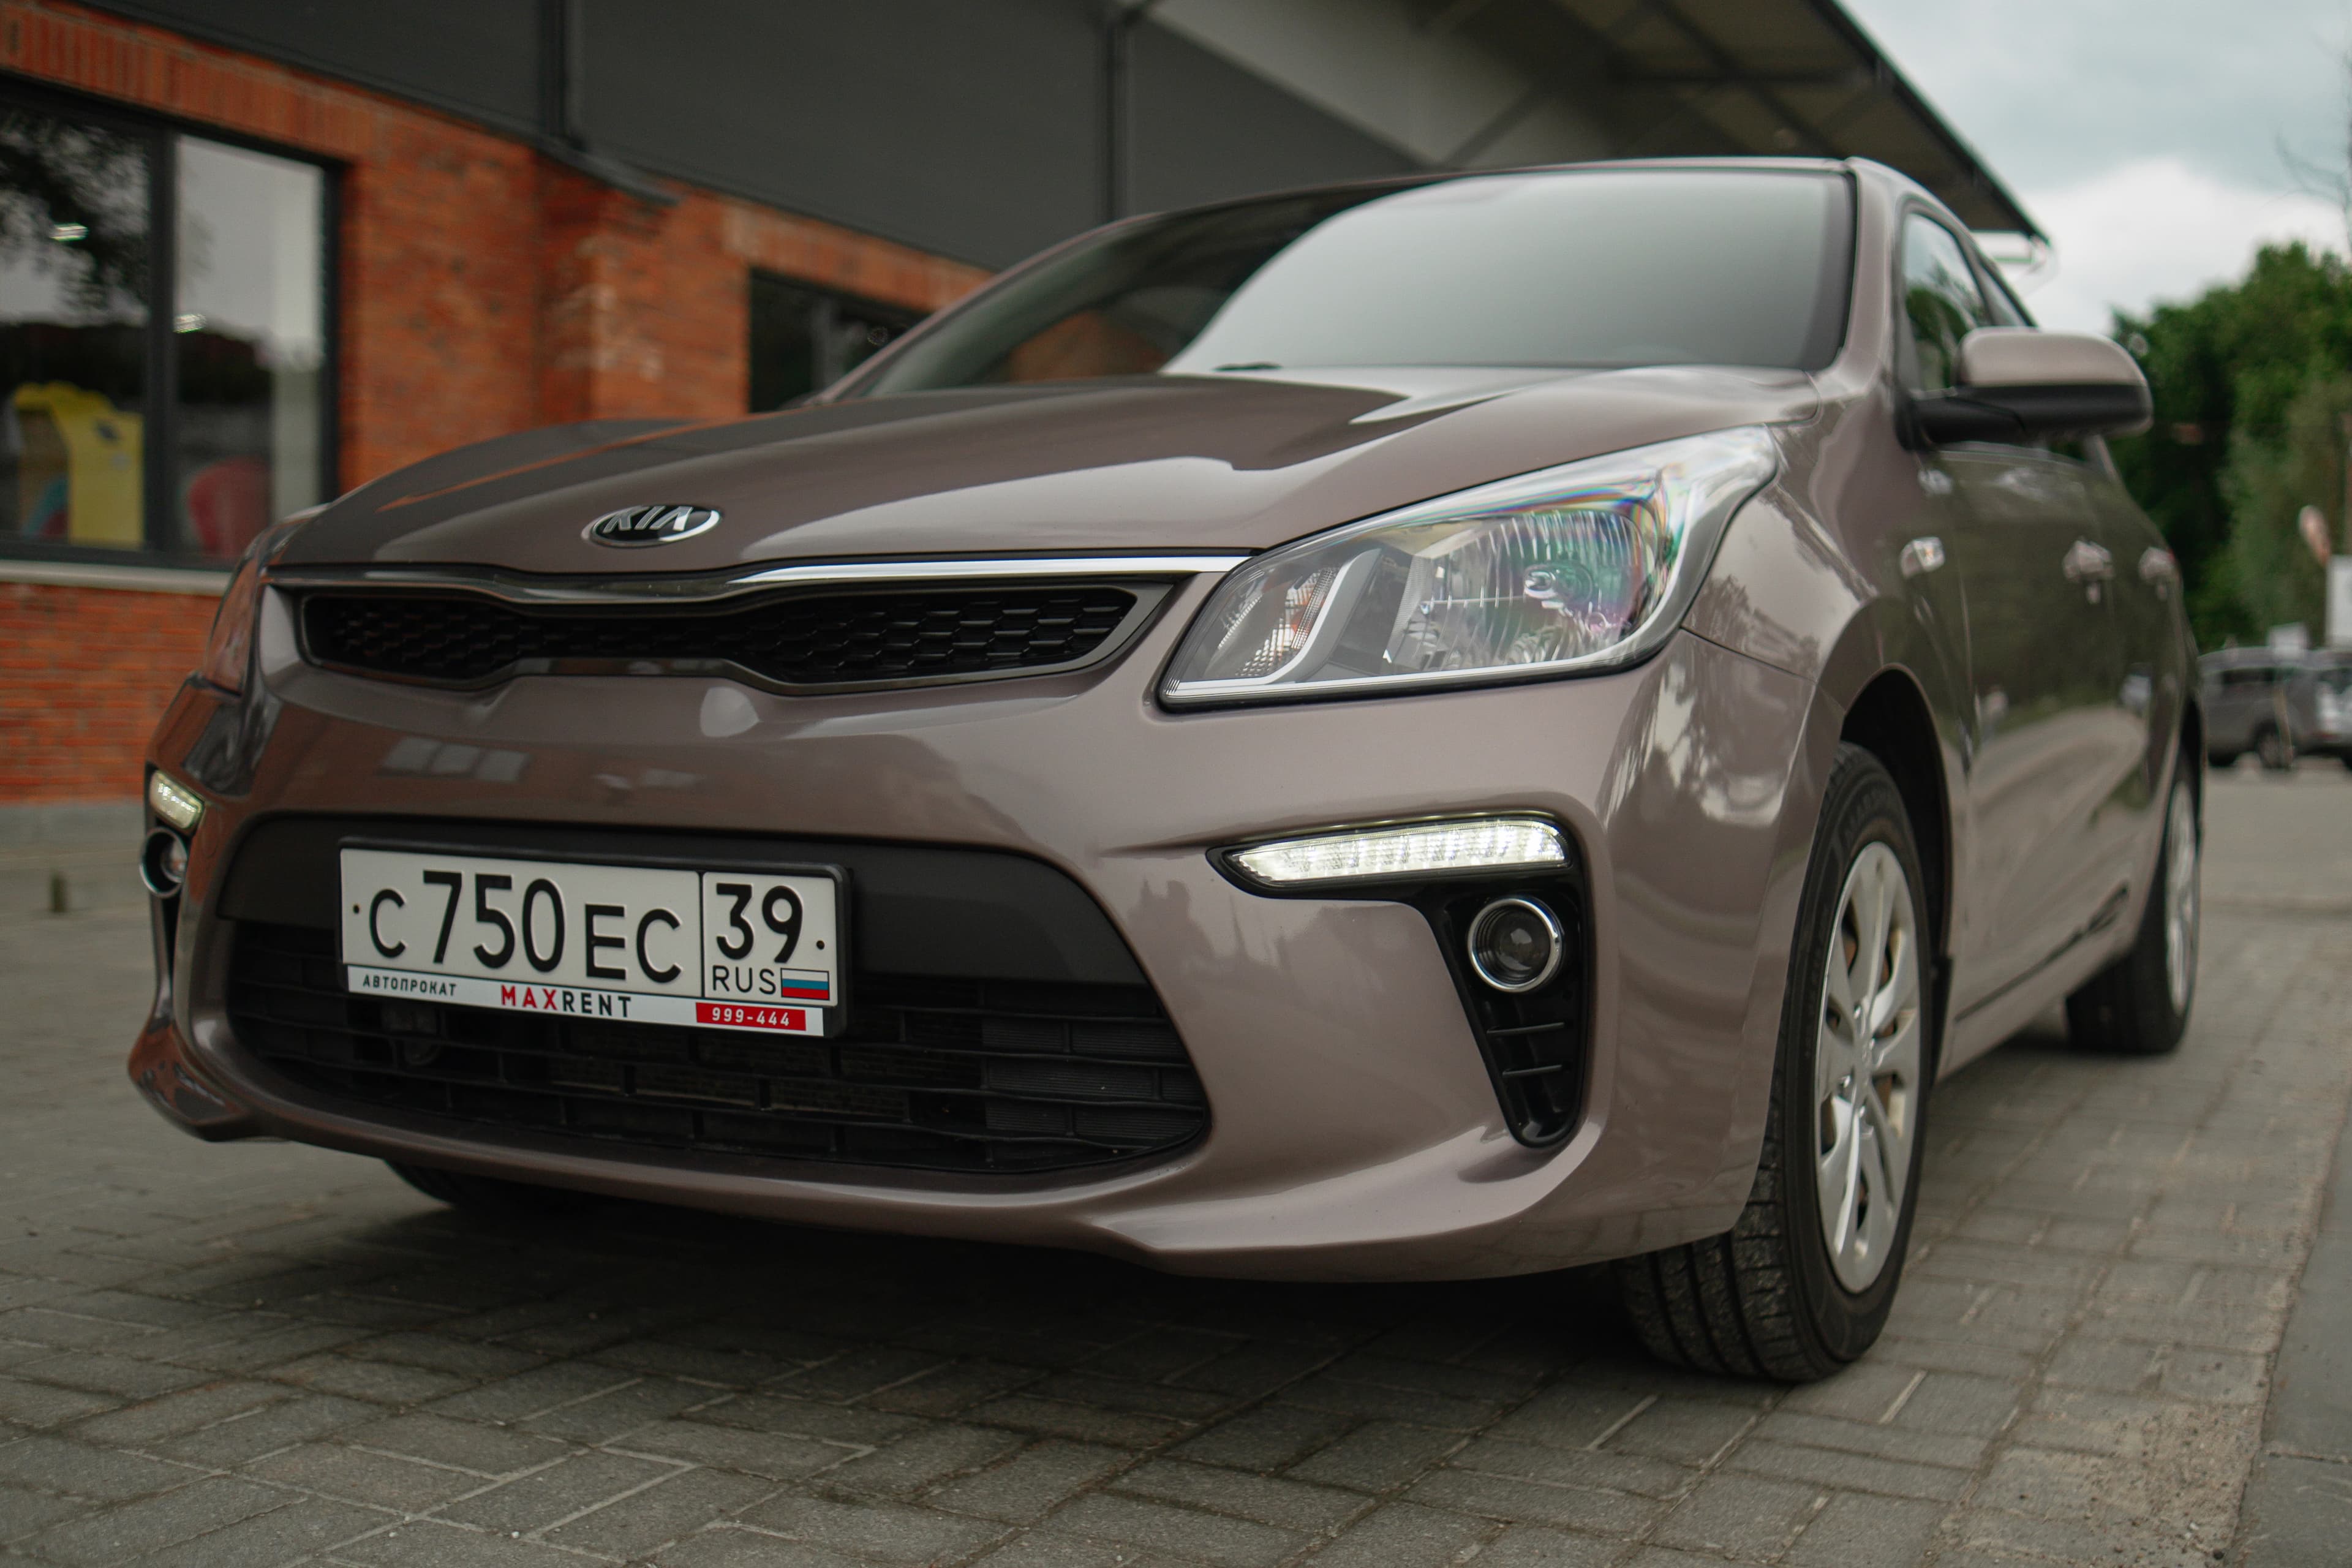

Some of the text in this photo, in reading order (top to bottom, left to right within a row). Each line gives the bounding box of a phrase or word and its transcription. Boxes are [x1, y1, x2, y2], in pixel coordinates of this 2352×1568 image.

[603, 505, 693, 533] KIA
[716, 883, 803, 963] 39
[363, 974, 458, 997] АВТОПРОКАТ
[713, 965, 777, 995] RUS
[501, 984, 631, 1017] MAXRENT
[712, 1007, 790, 1027] 999-444
